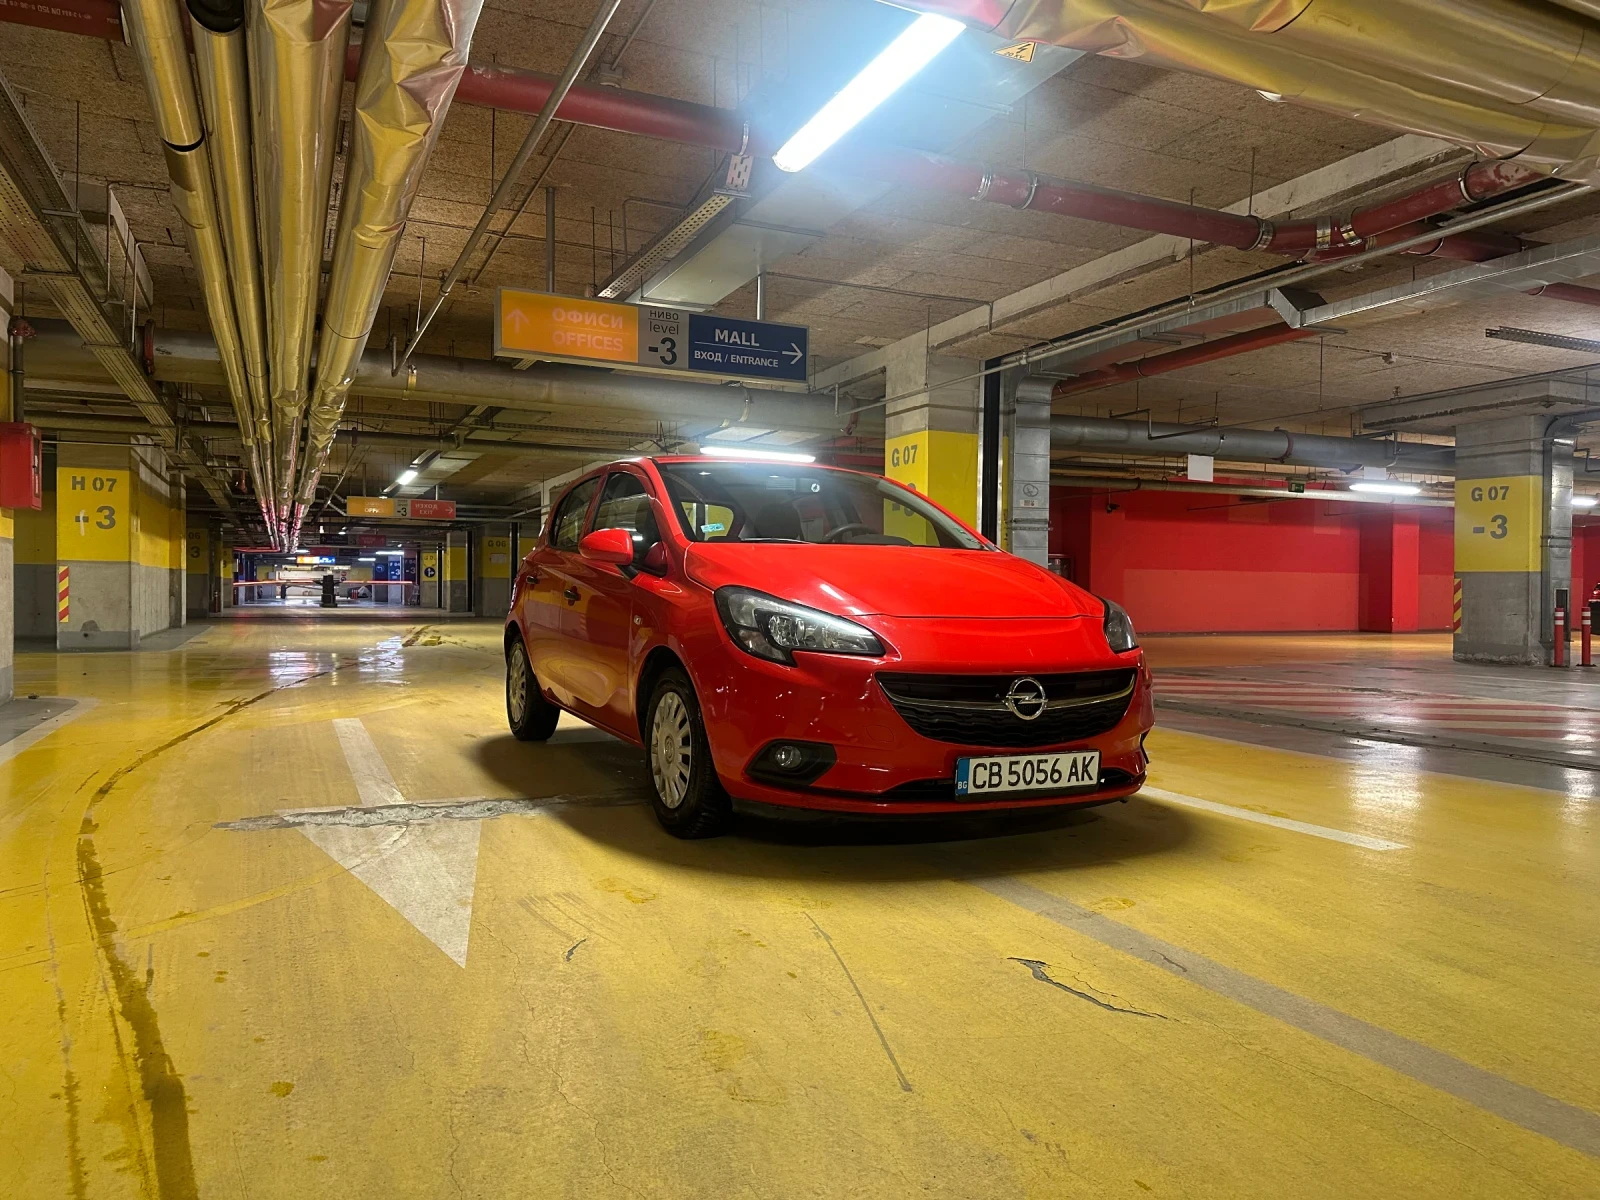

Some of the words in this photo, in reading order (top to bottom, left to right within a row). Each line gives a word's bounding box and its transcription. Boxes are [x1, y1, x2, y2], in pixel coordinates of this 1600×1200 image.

[552, 307, 623, 329] ОФИСИ
[649, 321, 679, 335] level
[552, 330, 624, 352] OFFICES
[715, 328, 760, 347] MALL
[648, 337, 677, 365] -3
[694, 350, 722, 363] ВХОД
[730, 354, 779, 368] ENTRANCE
[892, 448, 900, 468] G
[903, 444, 918, 465] 07
[71, 475, 86, 491] H
[92, 476, 117, 493] 07
[1471, 486, 1483, 502] G
[1488, 485, 1510, 501] 07
[1472, 514, 1508, 539] -3
[957, 781, 968, 790] BG
[972, 762, 1003, 789] CB
[1007, 758, 1063, 787] 5056
[1067, 755, 1096, 783] AK
